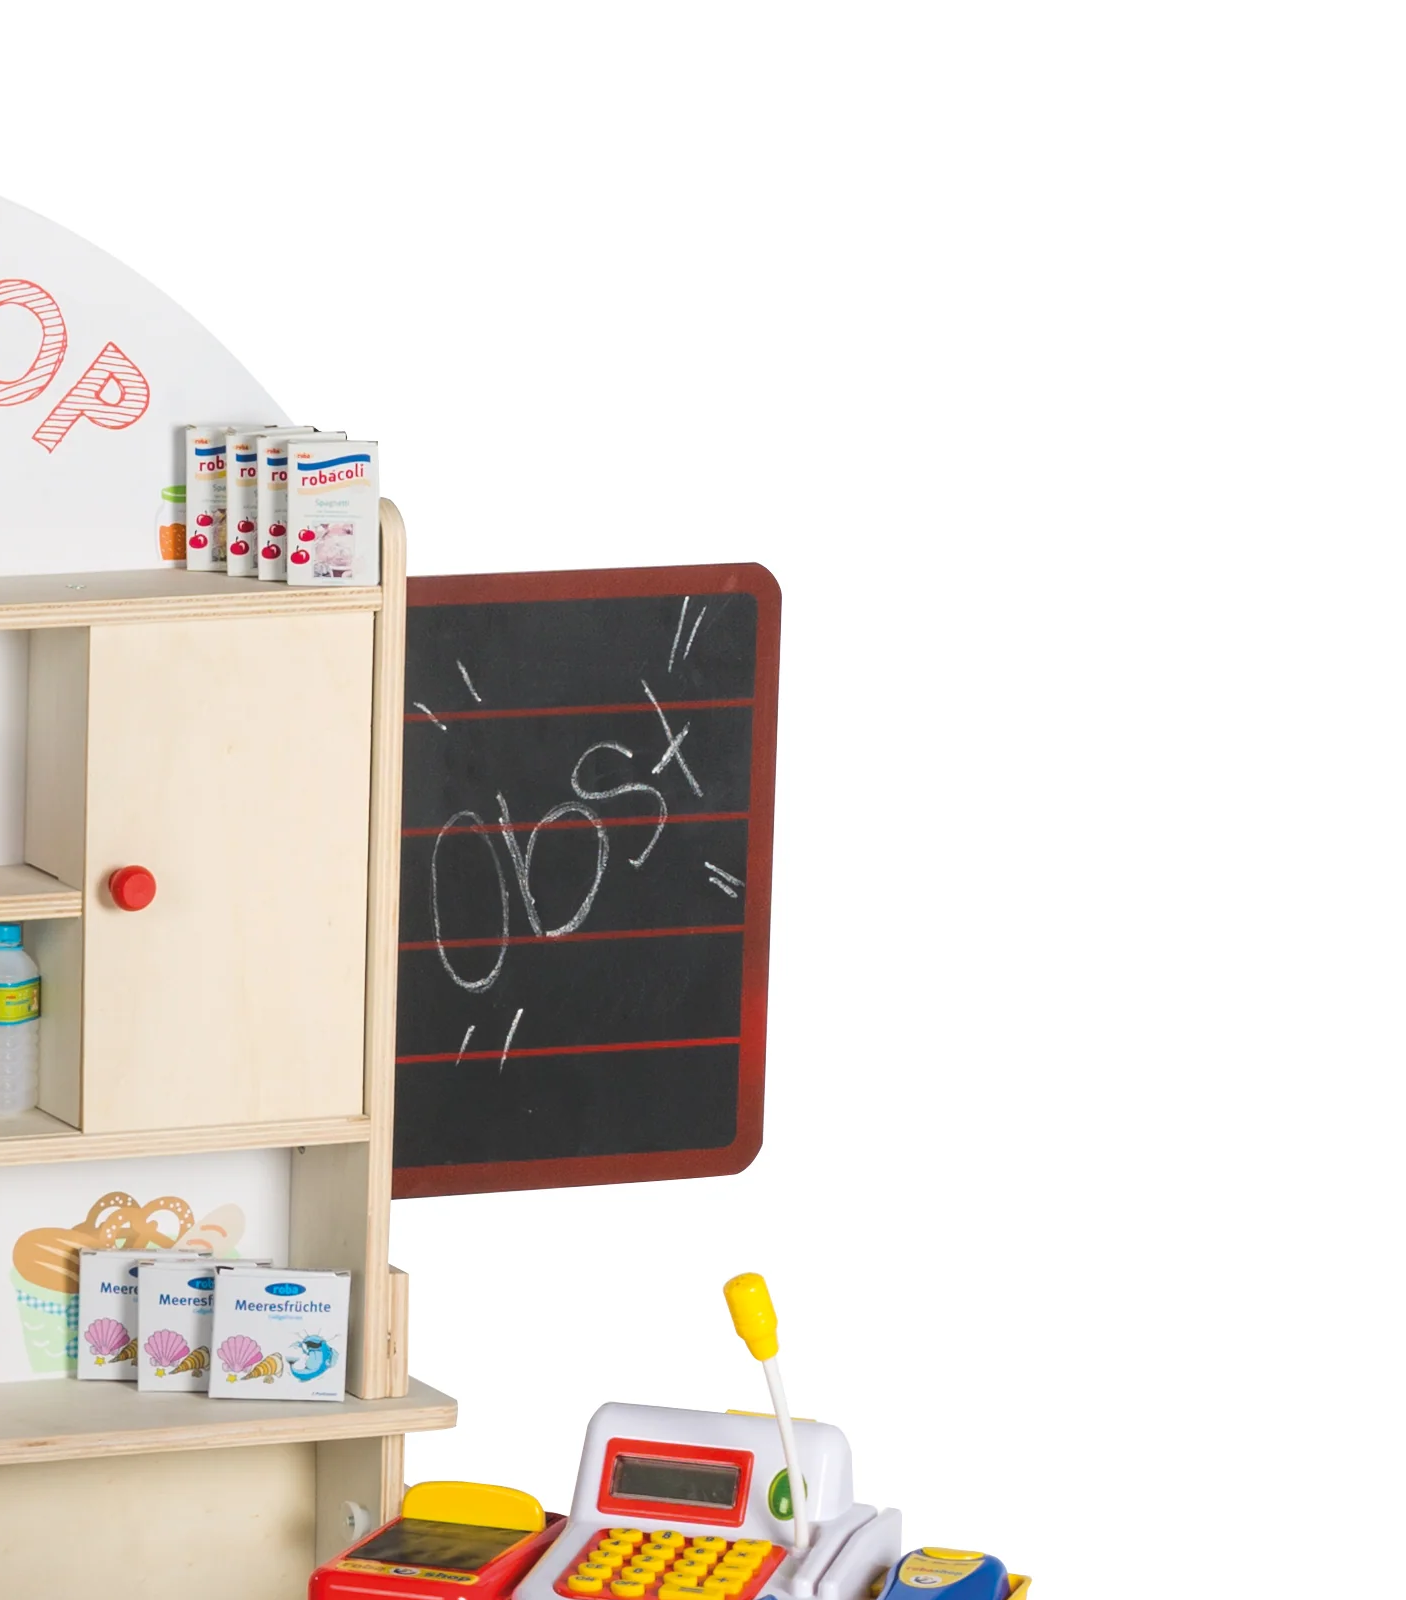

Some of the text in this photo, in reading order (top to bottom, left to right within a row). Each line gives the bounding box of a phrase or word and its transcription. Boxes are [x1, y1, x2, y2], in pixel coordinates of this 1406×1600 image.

[195, 1278, 215, 1289] rob
[273, 1283, 299, 1294] roba
[159, 1294, 214, 1306] Meeresf
[235, 1300, 331, 1312] Meeresfrüchte
[424, 1572, 470, 1581] shop
